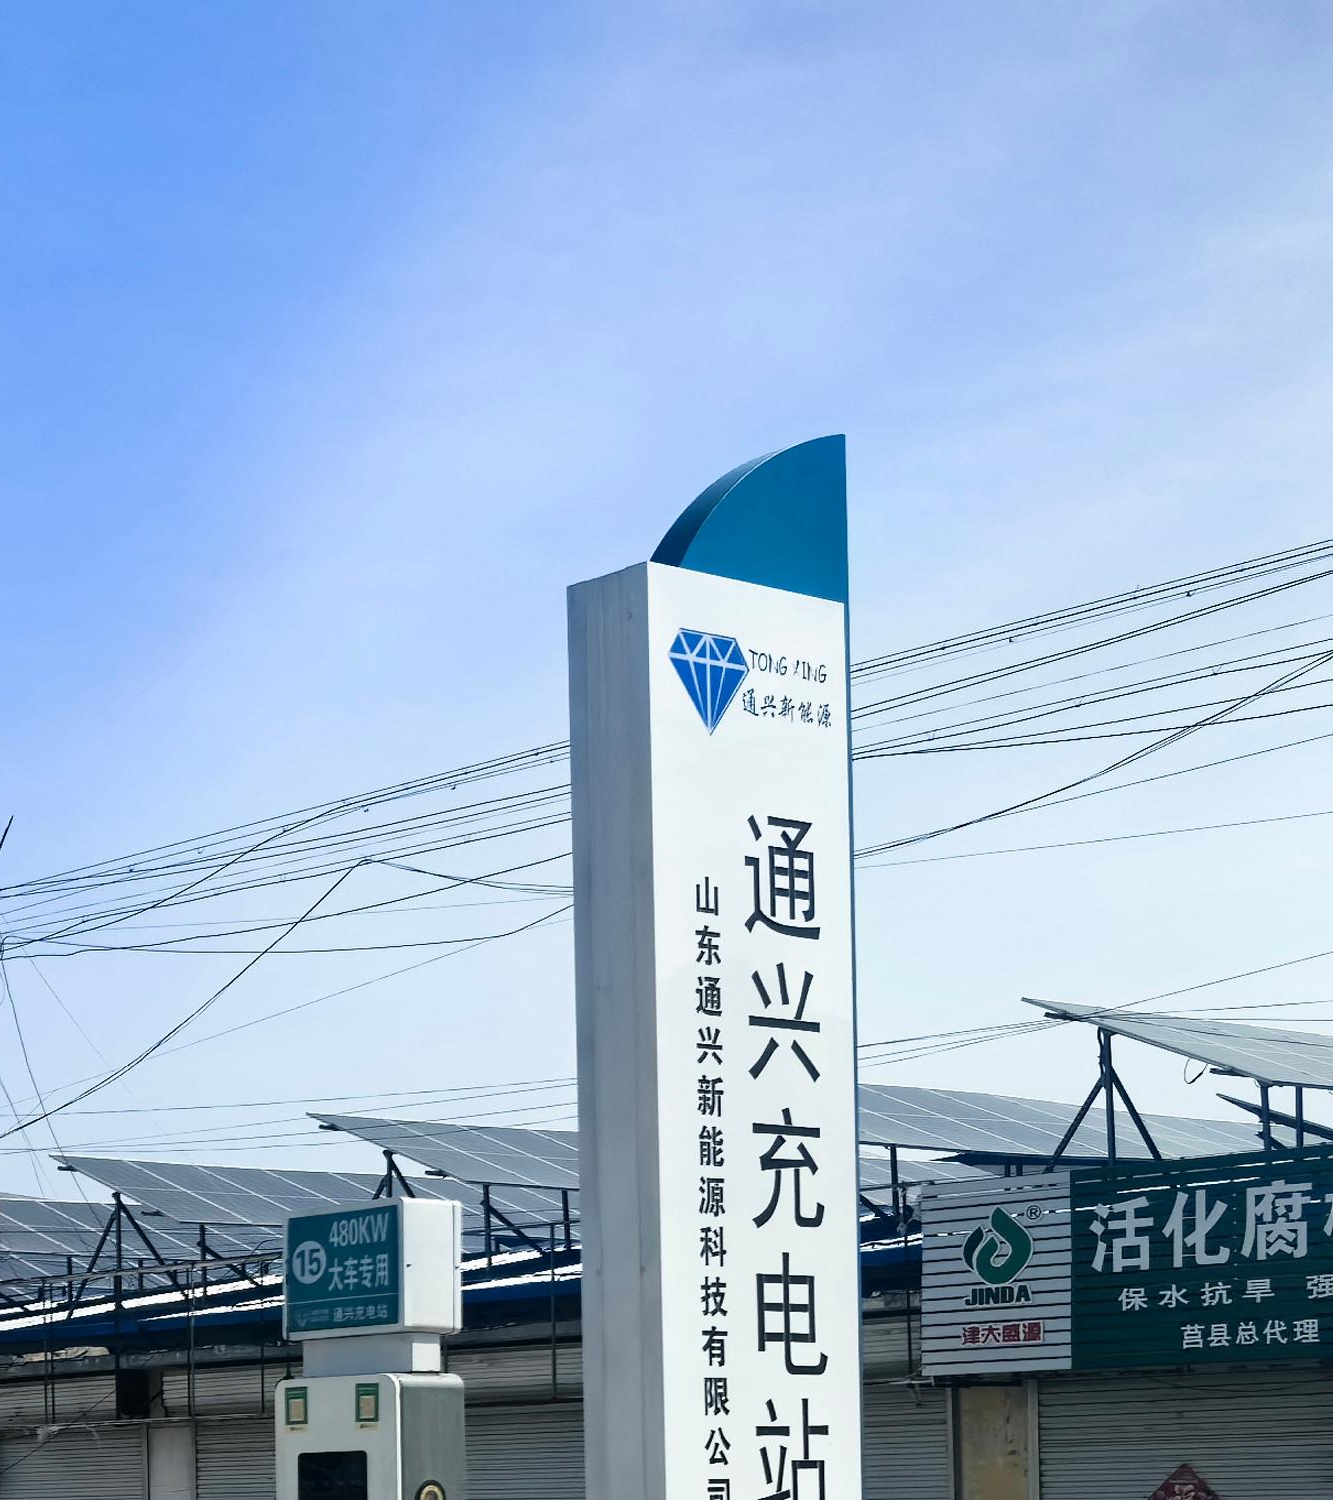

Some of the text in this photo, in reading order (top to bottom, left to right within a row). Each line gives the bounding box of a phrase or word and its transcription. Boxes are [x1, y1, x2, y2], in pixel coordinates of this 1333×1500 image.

[749, 649, 788, 676] TONG
[741, 688, 832, 728] 通兴新能源
[328, 1212, 389, 1247] 480KW
[295, 1248, 321, 1277] 15
[328, 1253, 389, 1291] 大车专用
[964, 1284, 1031, 1306] JINDA
[1118, 1278, 1275, 1311] 保水抗旱
[1181, 1319, 1320, 1349] 莒县总代理
